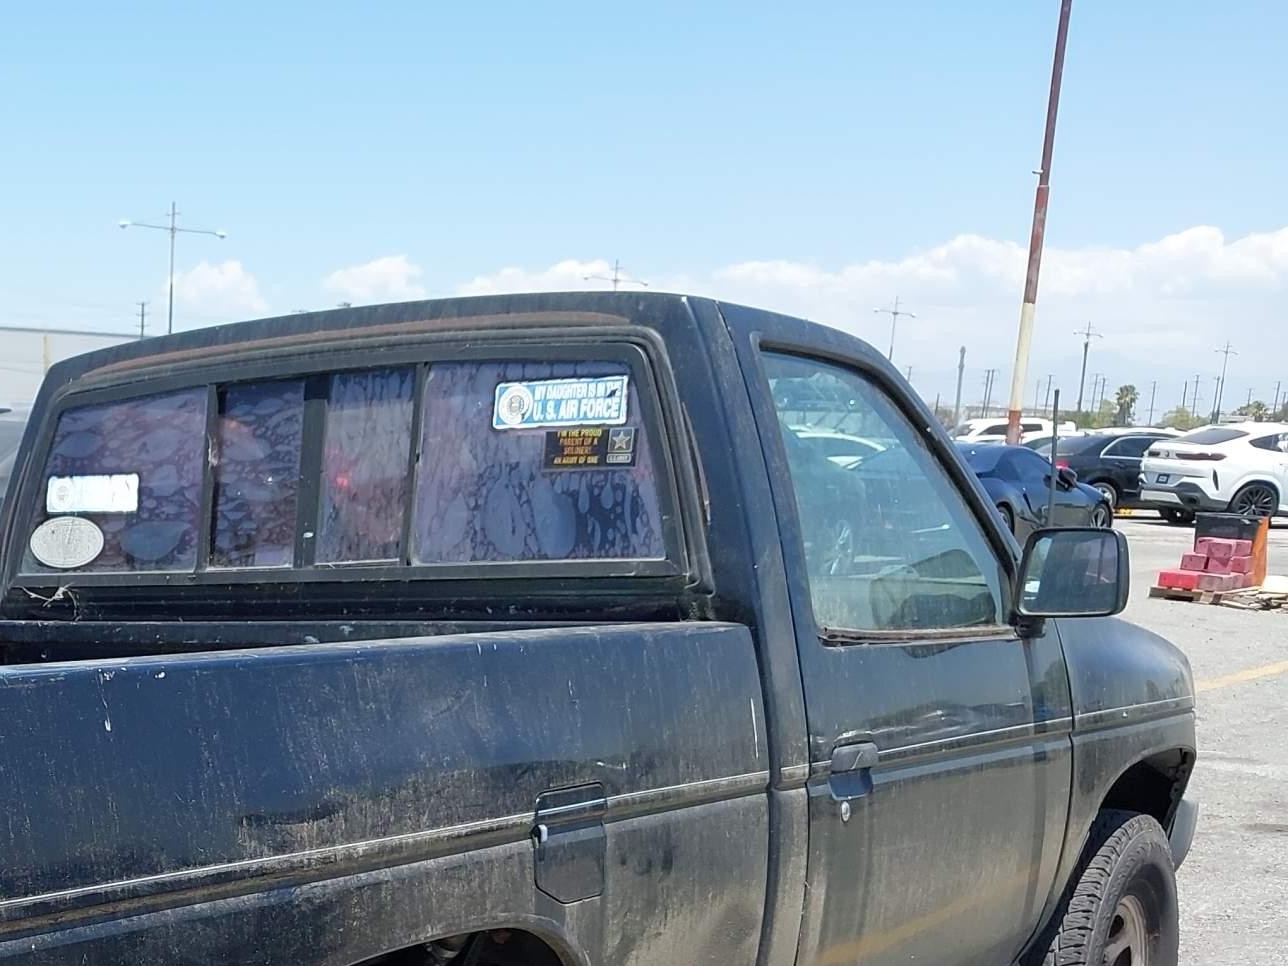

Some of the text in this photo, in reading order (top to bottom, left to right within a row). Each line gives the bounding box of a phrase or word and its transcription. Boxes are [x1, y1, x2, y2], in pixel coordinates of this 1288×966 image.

[534, 386, 546, 400] MY
[547, 384, 588, 399] DAUGHTER
[558, 400, 578, 419] AIR
[580, 398, 620, 418] FORCE
